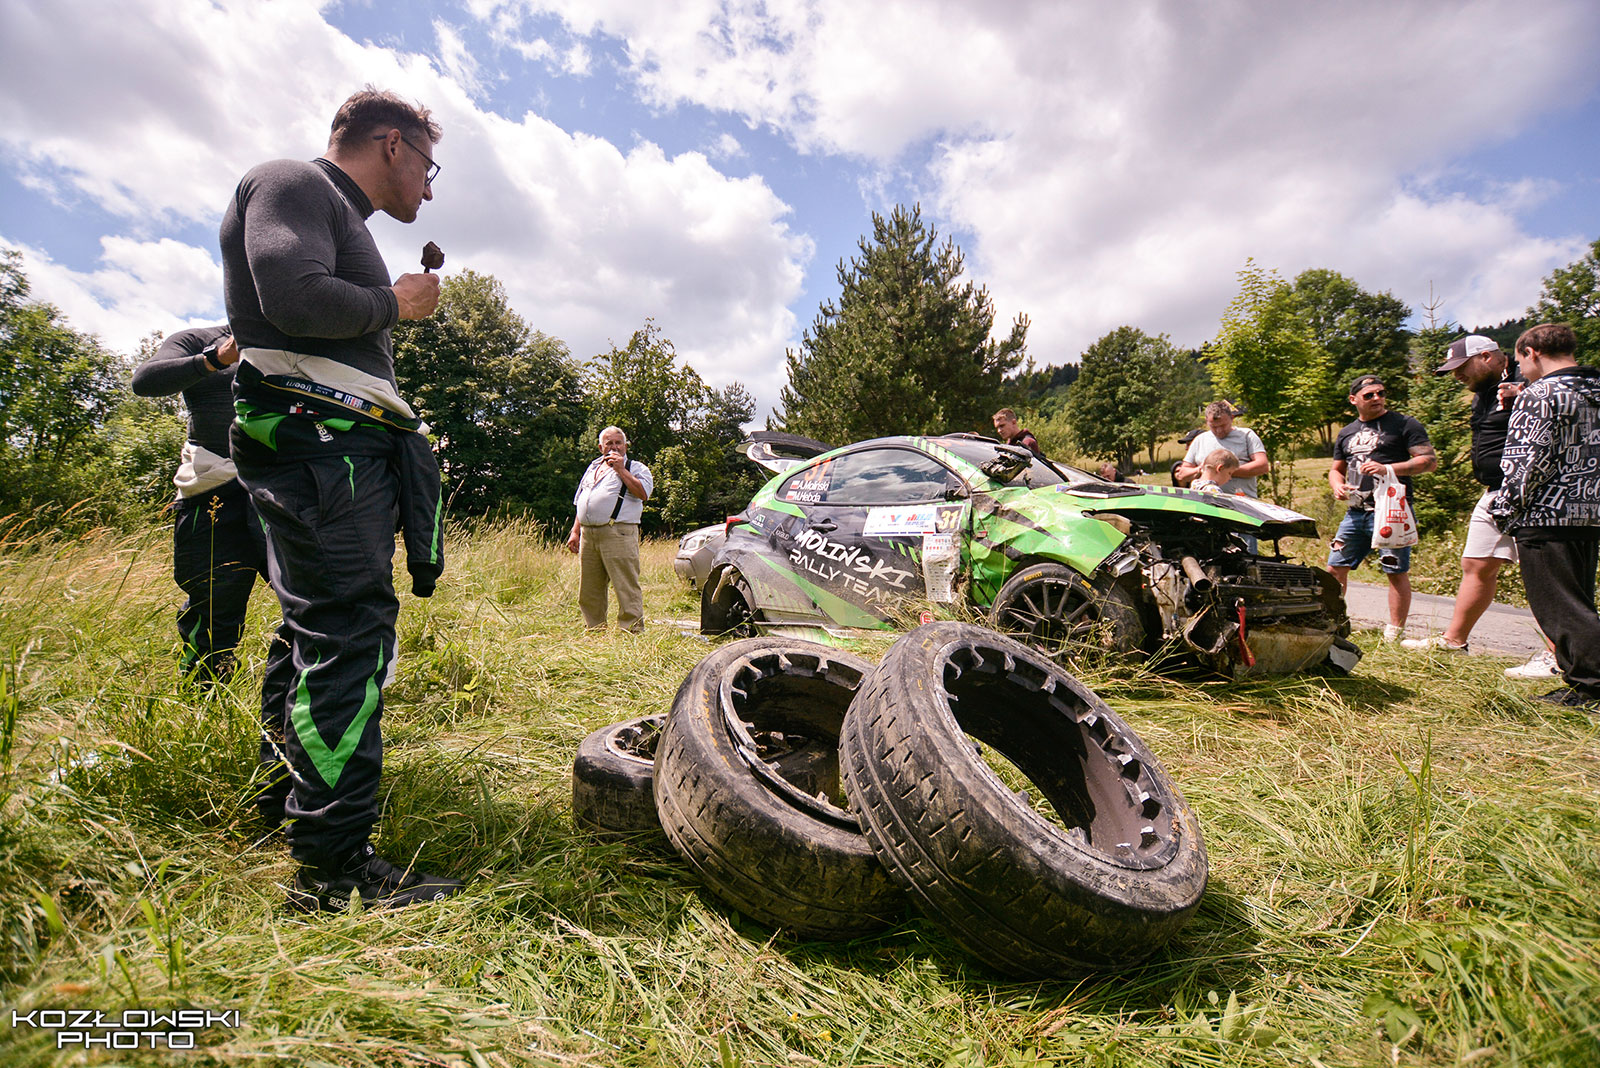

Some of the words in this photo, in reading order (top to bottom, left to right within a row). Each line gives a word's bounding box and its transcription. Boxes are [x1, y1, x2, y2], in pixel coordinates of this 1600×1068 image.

[804, 456, 832, 482] 31
[938, 510, 960, 530] 31
[789, 548, 841, 581] RALLY
[794, 528, 915, 589] MOLIŃSKI
